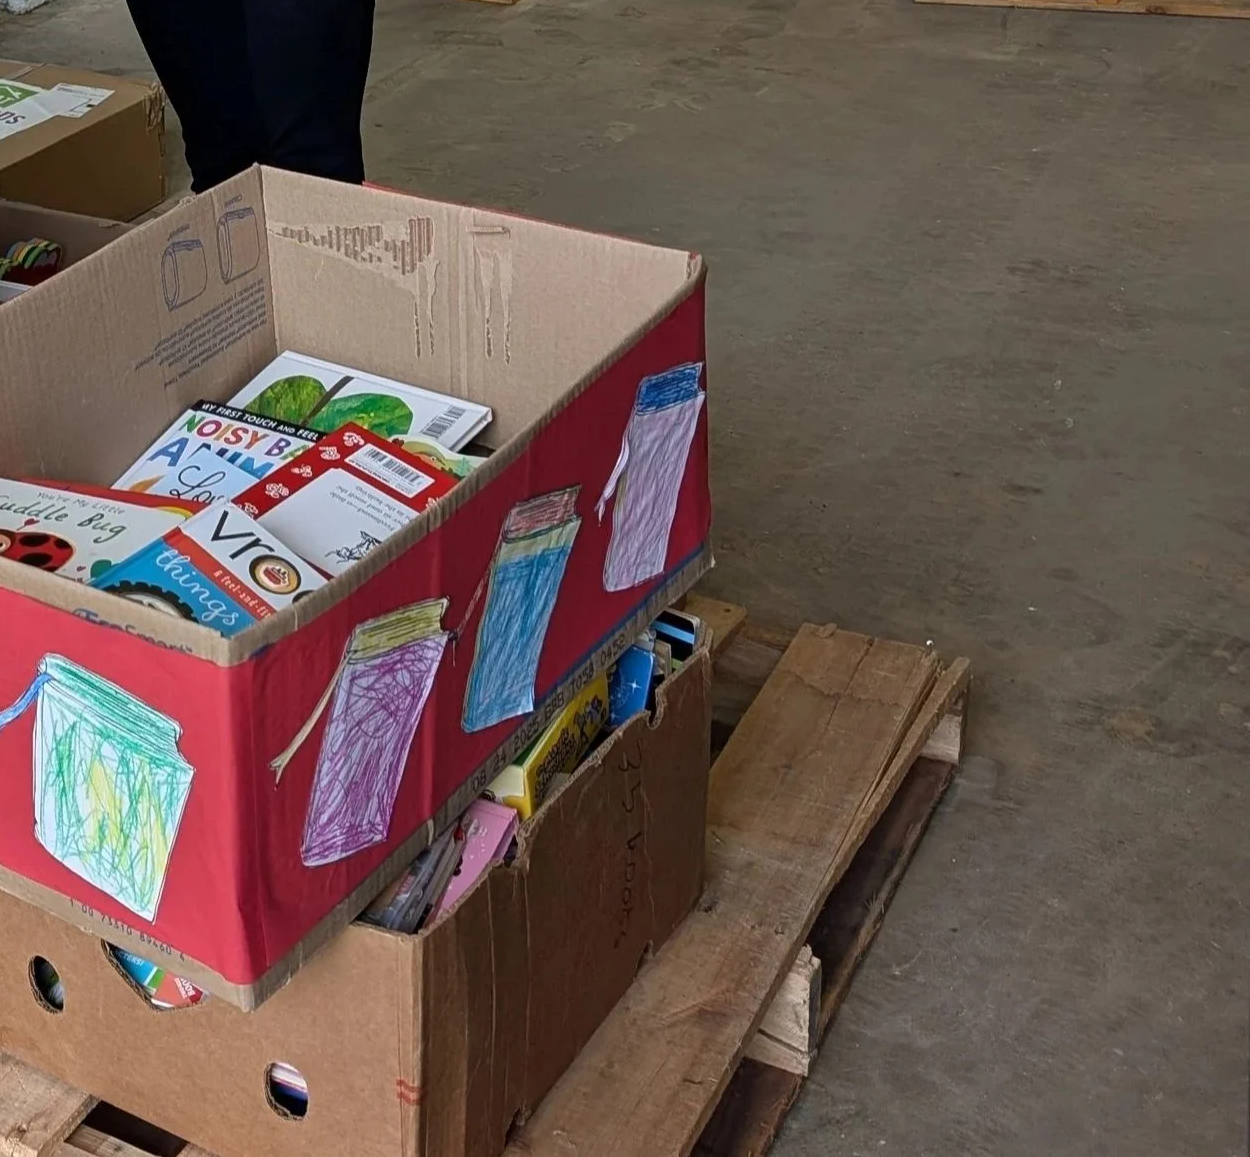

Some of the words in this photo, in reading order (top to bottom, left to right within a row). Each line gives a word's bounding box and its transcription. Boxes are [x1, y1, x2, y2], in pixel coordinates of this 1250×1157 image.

[178, 415, 270, 450] NOISY
[216, 406, 243, 421] FIRST
[243, 413, 277, 429] TOUCH
[277, 423, 296, 435] AND
[297, 428, 320, 441] FEEL
[36, 491, 71, 503] You're
[73, 498, 90, 509] My
[77, 512, 130, 544] Bug
[155, 549, 240, 627] things
